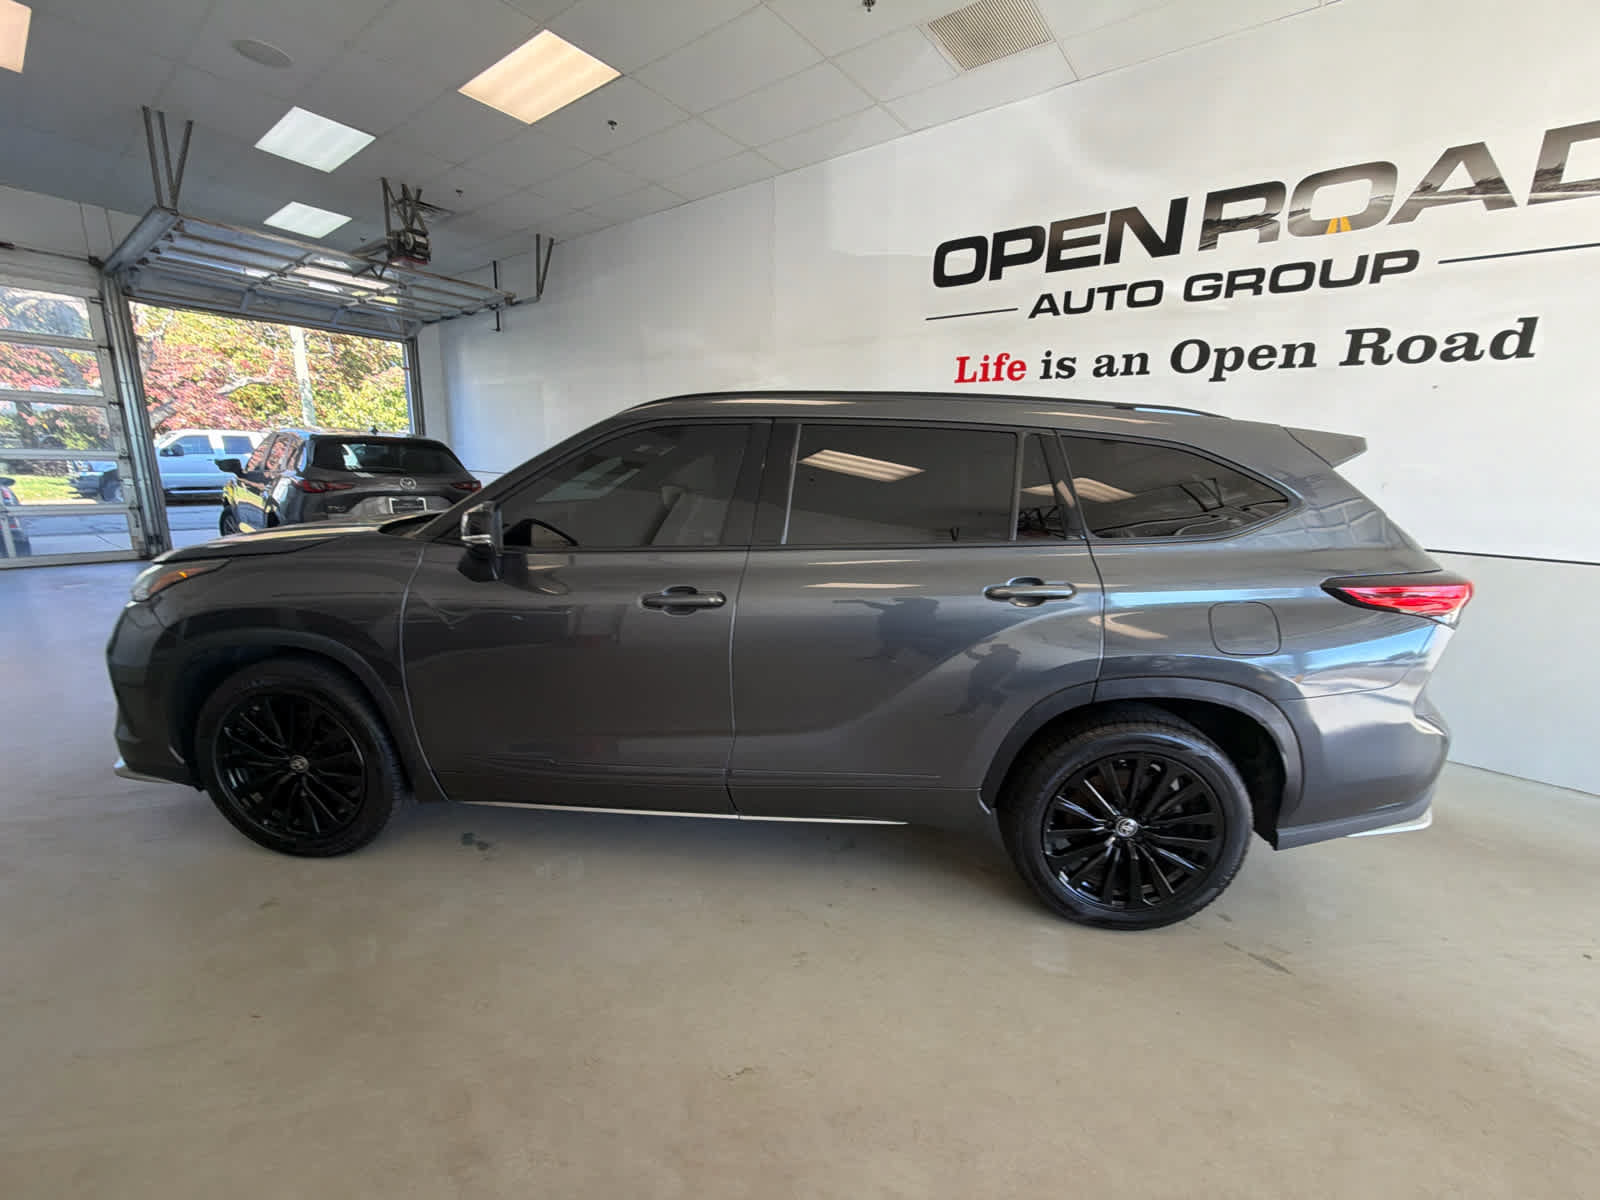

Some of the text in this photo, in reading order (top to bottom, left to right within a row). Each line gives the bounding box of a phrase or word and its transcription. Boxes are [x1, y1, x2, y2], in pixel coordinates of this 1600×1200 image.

[932, 196, 1189, 289] OPEN
[1027, 249, 1420, 320] AUTO GROUP
[954, 316, 1539, 384] Life is an Open Road
